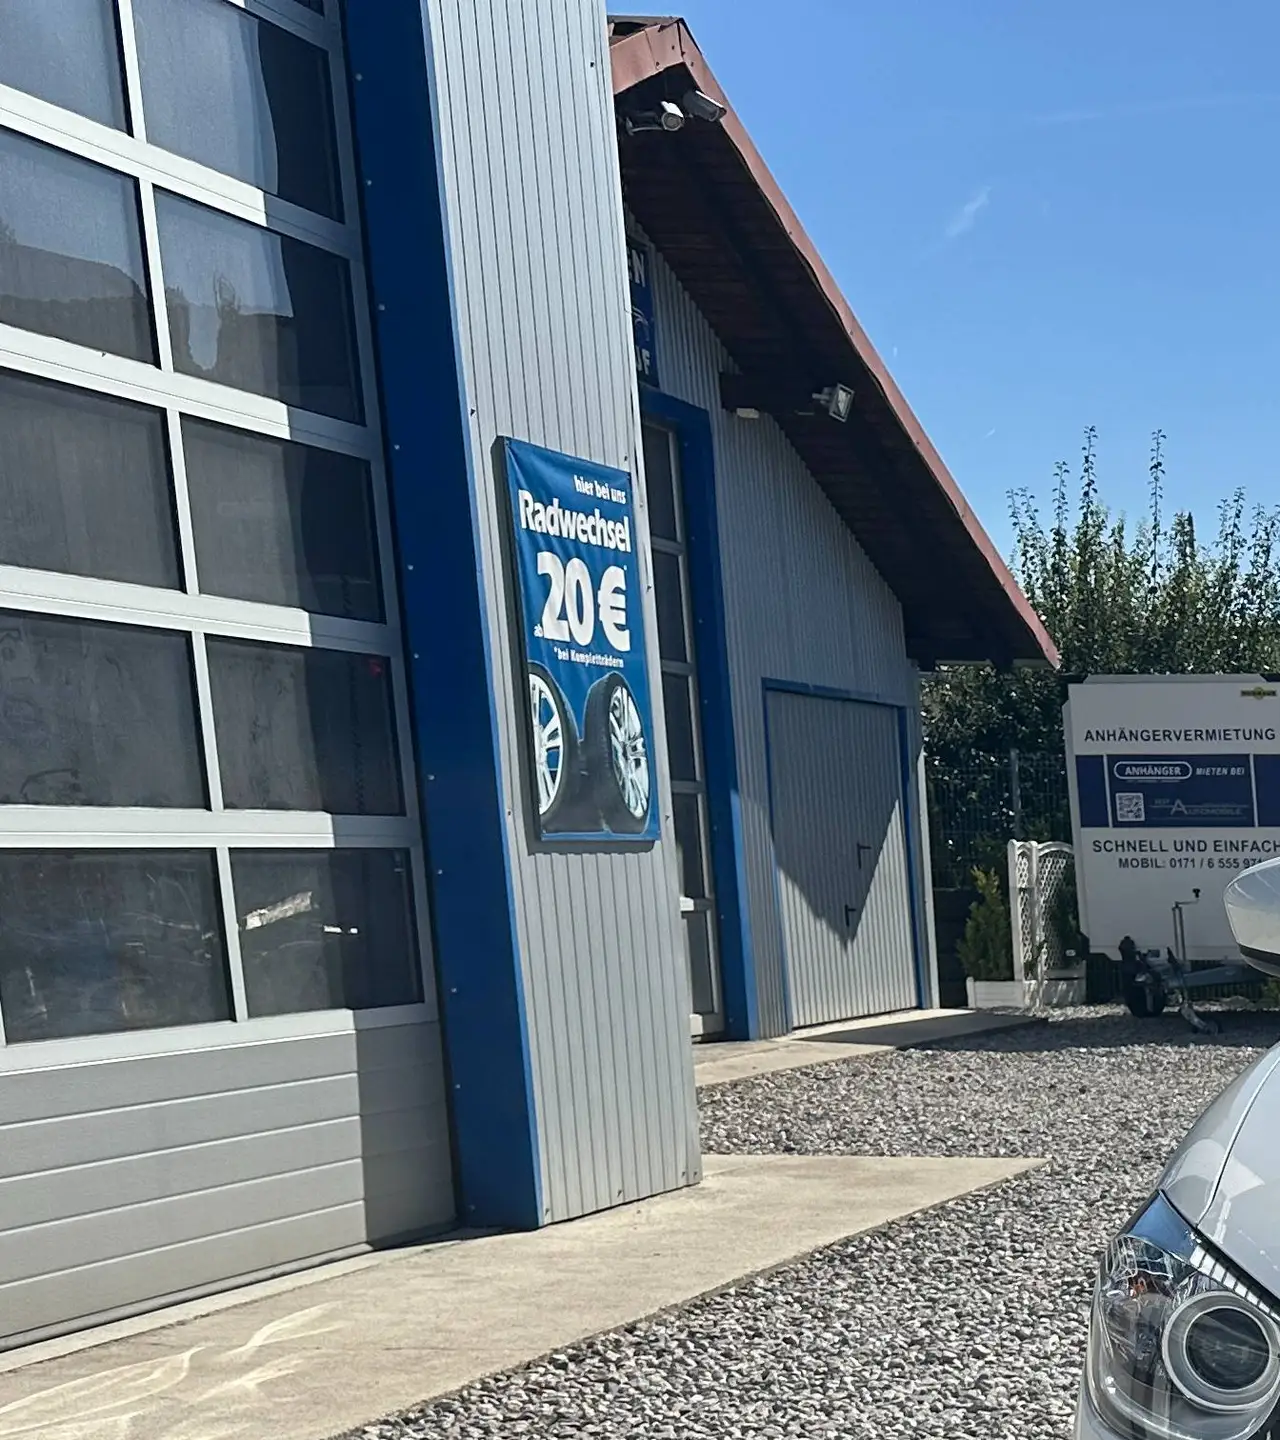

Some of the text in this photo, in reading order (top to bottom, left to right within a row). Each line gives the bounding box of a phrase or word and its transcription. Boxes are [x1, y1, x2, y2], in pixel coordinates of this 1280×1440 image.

[573, 474, 627, 505] hier bei uns
[518, 488, 632, 553] Radwechsel
[537, 551, 595, 646] 20
[1084, 726, 1276, 743] ANHÄNGERVERMIETUNG
[1125, 765, 1182, 776] ANHÄNGER
[1195, 766, 1228, 776] MIETEN
[1092, 839, 1169, 853] SCHNELL
[1173, 839, 1208, 853] UND
[1118, 857, 1165, 869] MOBIL:
[1169, 857, 1196, 869] 0171
[1207, 857, 1215, 869] 6
[1218, 857, 1240, 869] 555
